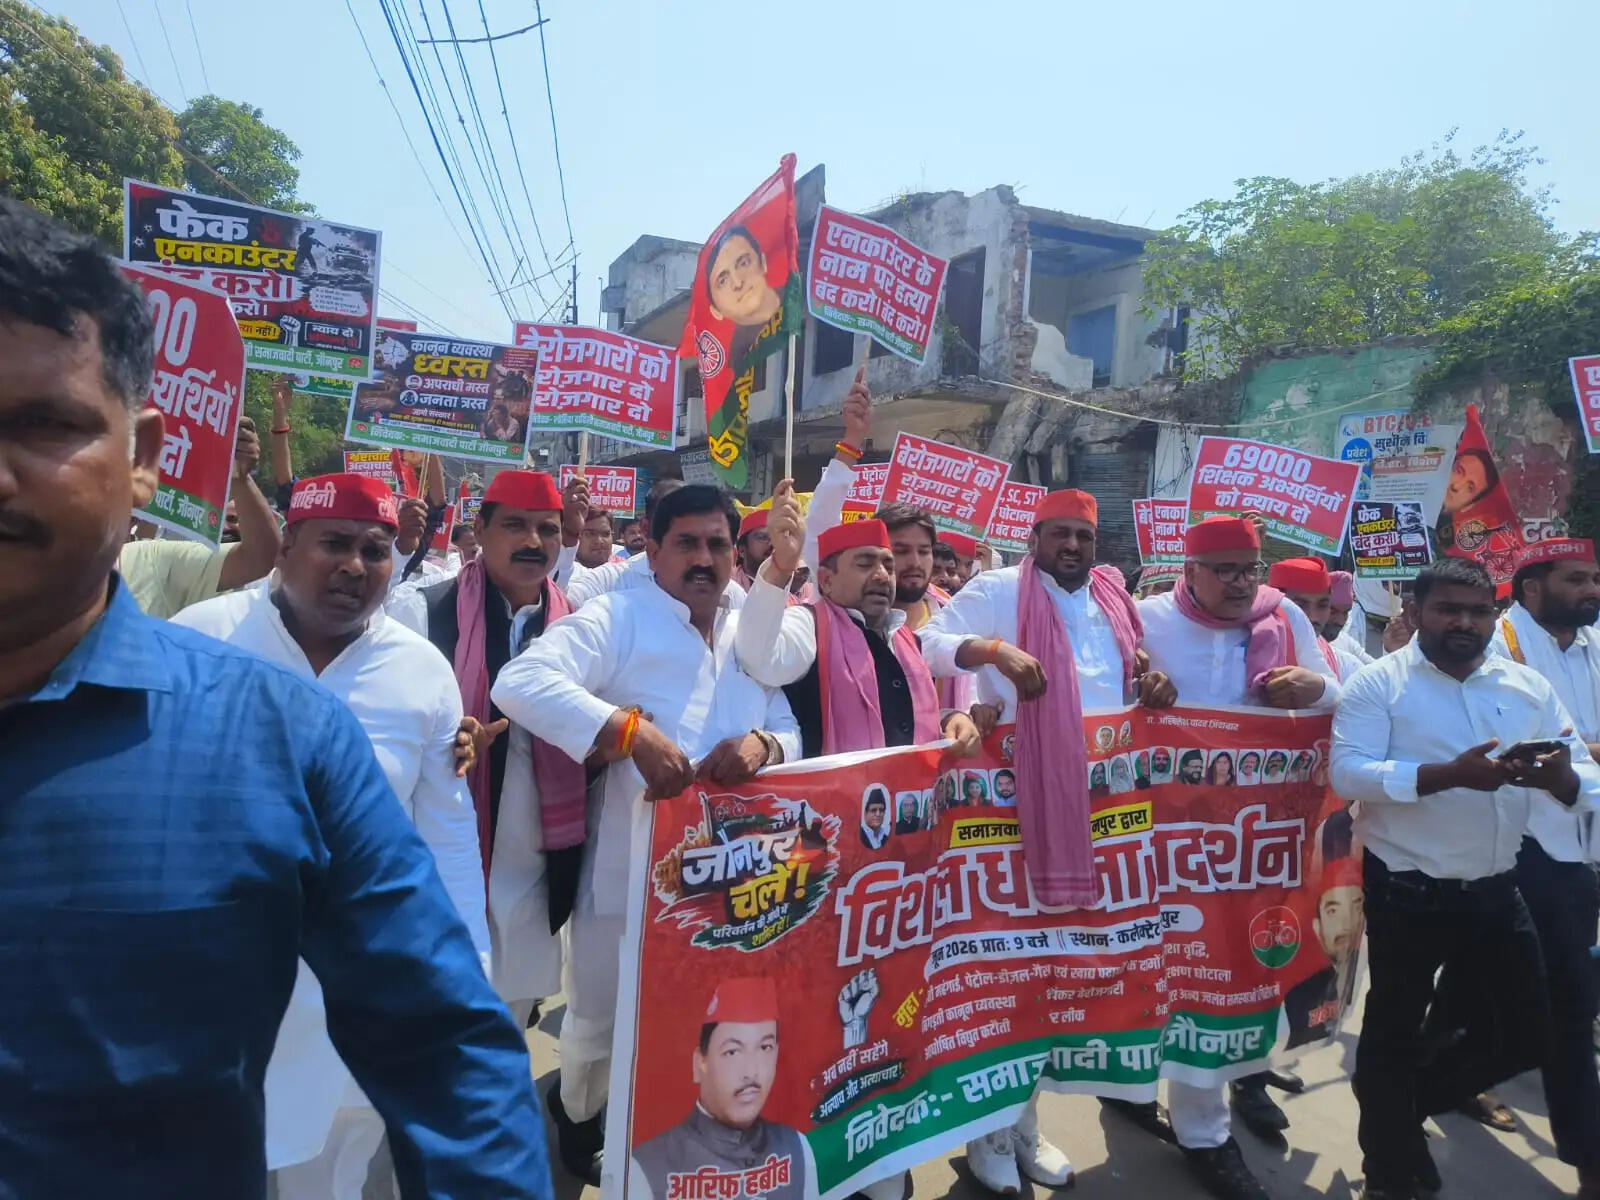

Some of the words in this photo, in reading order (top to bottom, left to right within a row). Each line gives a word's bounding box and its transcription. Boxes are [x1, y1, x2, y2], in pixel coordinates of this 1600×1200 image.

[156, 199, 249, 242] फेक
[153, 238, 297, 271] एनकाउंटर
[828, 220, 917, 279] एनकाउंटर
[915, 254, 936, 287] के
[819, 248, 871, 284] नाम
[873, 264, 896, 296] पर
[894, 277, 932, 315] हत्या
[814, 277, 840, 304] बंद
[880, 299, 897, 328] बंद
[411, 339, 449, 357] कानून
[451, 342, 494, 359] व्यवस्था
[413, 353, 491, 380] ध्वस्त
[639, 350, 671, 383] को
[422, 377, 464, 393] अपराधी
[465, 381, 490, 395] मस्त
[628, 381, 654, 402] दो
[419, 392, 458, 408] जनता
[460, 396, 488, 411] त्रस्त
[626, 402, 653, 422] दो
[896, 439, 979, 483] बेरोजगारों
[972, 465, 1002, 491] को
[1223, 443, 1312, 482] 69000
[596, 470, 633, 492] लीक
[1198, 464, 1257, 487] शिक्षक
[1258, 474, 1347, 514] अभ्यर्थियों
[960, 488, 982, 505] दो
[1215, 487, 1242, 508] को
[1242, 492, 1290, 517] न्याय
[1289, 505, 1312, 525] दो
[955, 504, 977, 520] दो
[1154, 505, 1186, 520] एनका
[1357, 504, 1381, 523] फेक
[957, 822, 1021, 841] समाजवा
[1119, 808, 1148, 831] द्वारा
[712, 920, 756, 938] परिवर्तन
[946, 940, 978, 960] 2026
[1013, 936, 1025, 950] 9
[1024, 931, 1050, 949] बजे
[1193, 965, 1232, 982] घोटाला
[945, 1000, 973, 1022] कानून
[975, 995, 1017, 1012] व्यवस्था
[980, 1017, 1012, 1038] कटौती
[822, 1066, 838, 1086] अब
[837, 1045, 858, 1075] नहीं
[859, 1040, 889, 1065] सहेंगे
[845, 1079, 860, 1099] और
[667, 1165, 742, 1200] आरिफ
[743, 1154, 792, 1196] हबीब
